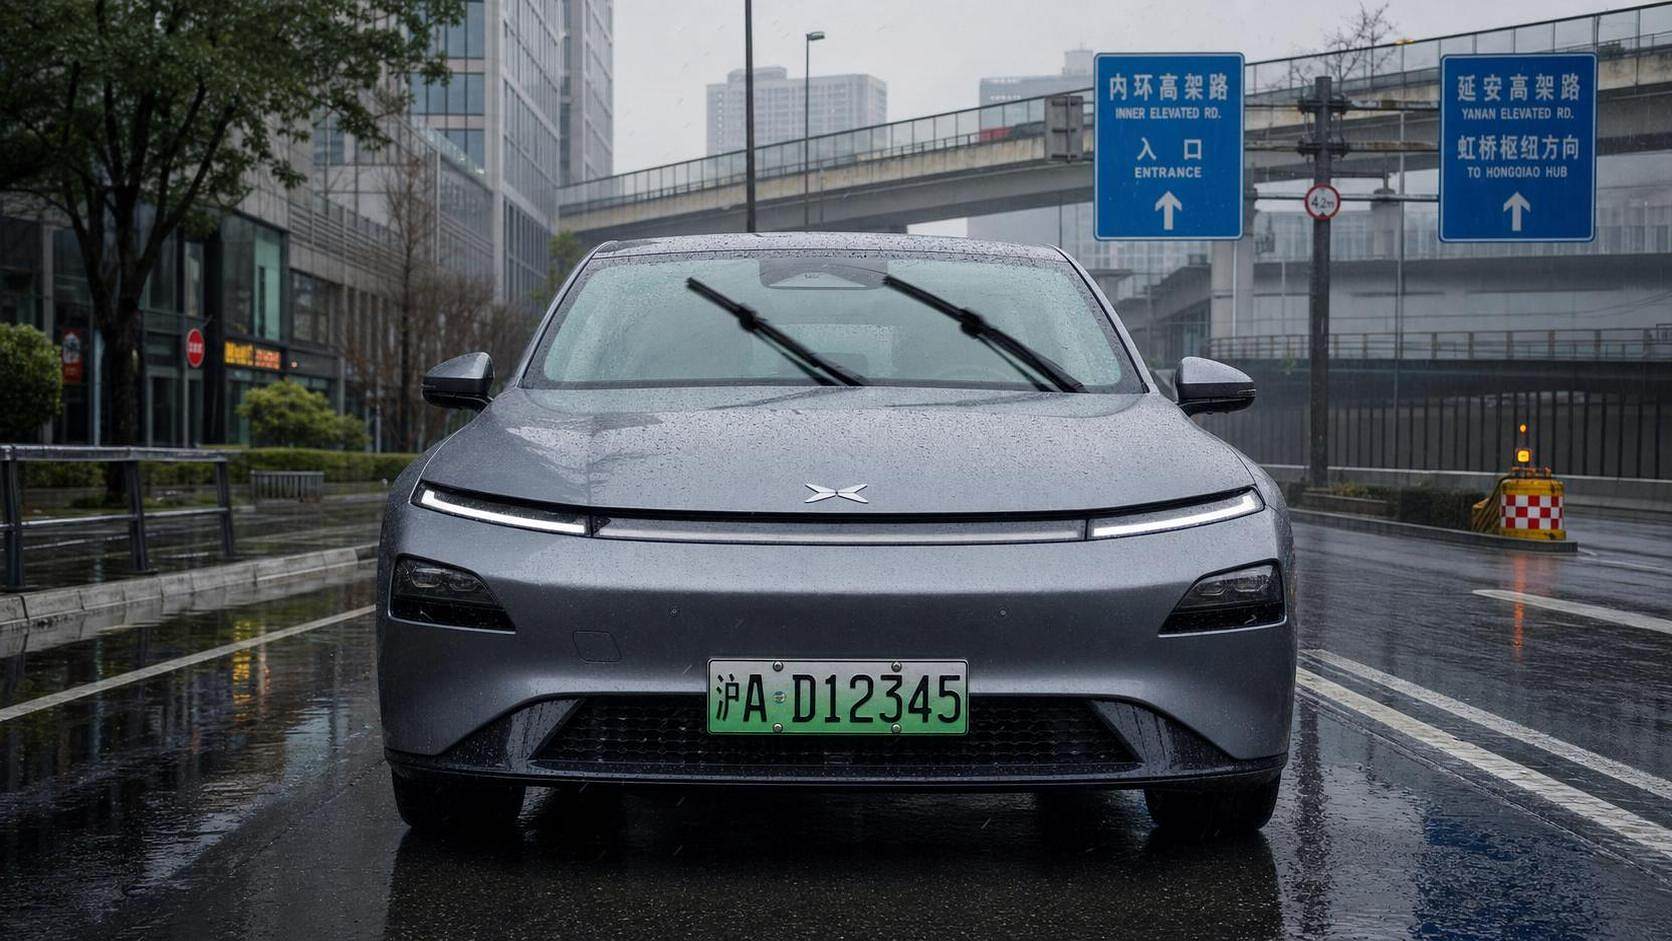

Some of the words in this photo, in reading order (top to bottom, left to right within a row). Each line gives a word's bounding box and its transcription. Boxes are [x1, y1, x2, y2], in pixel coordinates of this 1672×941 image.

[1109, 73, 1229, 101] 内环高架路
[1457, 73, 1581, 101] 延安高架路
[1115, 107, 1146, 119] INNER
[1149, 107, 1200, 119] ELEVATED
[1204, 107, 1222, 119] RD.
[1461, 107, 1496, 119] YANAN
[1500, 107, 1552, 119] ELEVATED
[1556, 107, 1575, 119] RD.
[1136, 137, 1202, 160] 入口
[1457, 134, 1580, 160] 虹桥枢纽方向
[1134, 166, 1203, 178] ENTRANCE
[1467, 166, 1481, 178] TO
[1486, 166, 1541, 179] HONGQIAO
[1545, 166, 1569, 178] HUB
[791, 673, 962, 724] D12345
